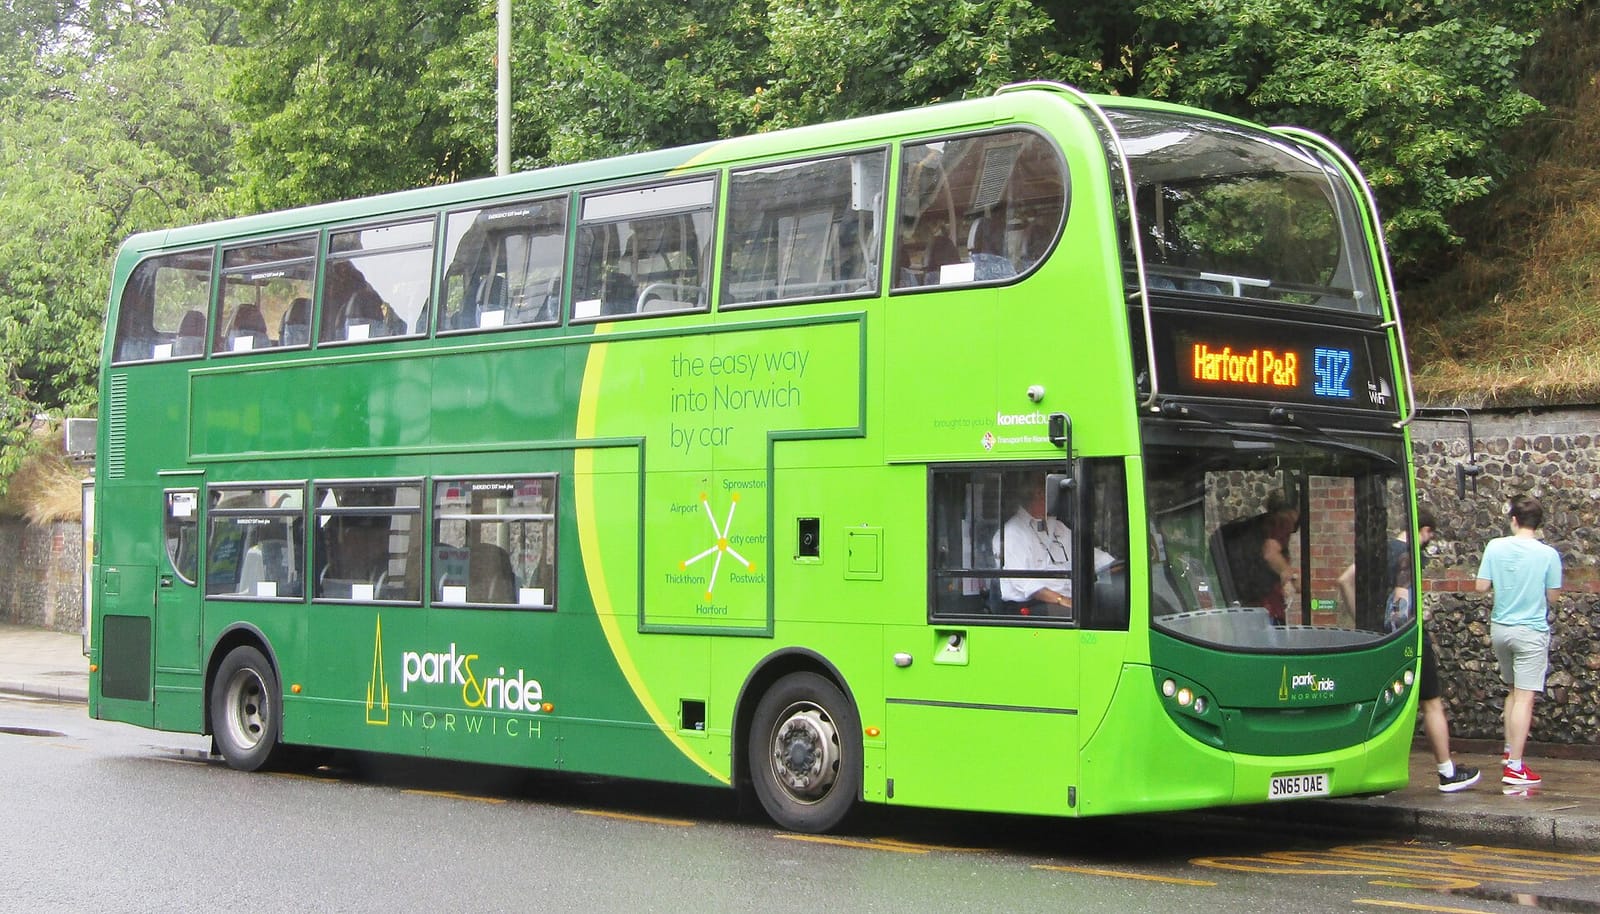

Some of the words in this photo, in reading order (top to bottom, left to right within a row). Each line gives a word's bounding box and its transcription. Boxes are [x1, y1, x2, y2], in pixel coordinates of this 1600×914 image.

[671, 352, 704, 378] the
[709, 353, 759, 381] easy
[764, 350, 810, 378] way
[1194, 344, 1258, 384] Harford
[1262, 350, 1297, 386] P&R
[1314, 348, 1351, 397] 502
[671, 388, 708, 413] into
[713, 380, 801, 411] Norwich
[997, 410, 1049, 425] konectbu
[670, 422, 695, 455] by
[699, 425, 734, 447] car
[722, 478, 766, 491] Sprowston
[670, 503, 698, 516] Airport
[730, 535, 744, 546] city
[745, 534, 767, 544] centr
[664, 574, 705, 584] Thickthorn
[730, 573, 766, 584] Postwick
[696, 604, 728, 615] Harford
[1291, 692, 1335, 700] NORWICH
[402, 710, 542, 739] NORWICH
[1272, 777, 1300, 795] SN65
[1302, 775, 1323, 793] OAE
